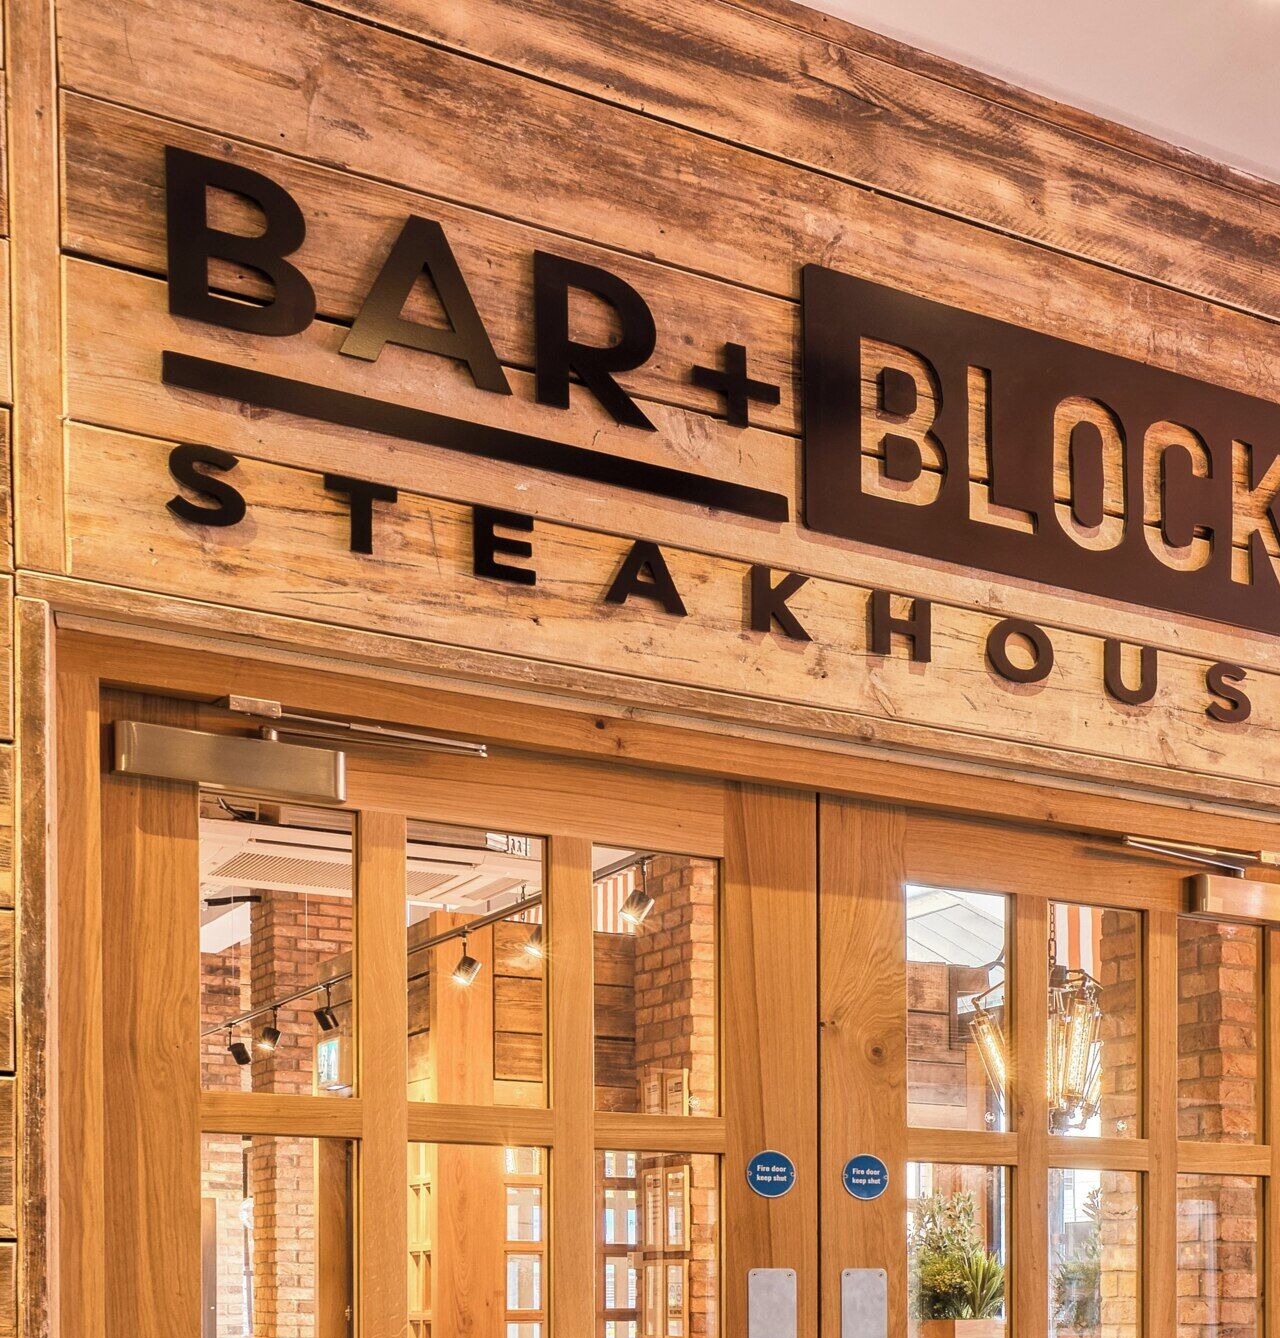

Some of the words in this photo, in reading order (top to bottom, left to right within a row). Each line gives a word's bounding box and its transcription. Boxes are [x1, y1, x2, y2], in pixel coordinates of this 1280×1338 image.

[757, 1165, 770, 1173] Fire
[771, 1165, 786, 1173] door
[865, 1168, 880, 1176] door
[756, 1174, 771, 1182] keep
[773, 1174, 787, 1182] shut
[852, 1177, 866, 1185] keep
[868, 1177, 881, 1185] shut
